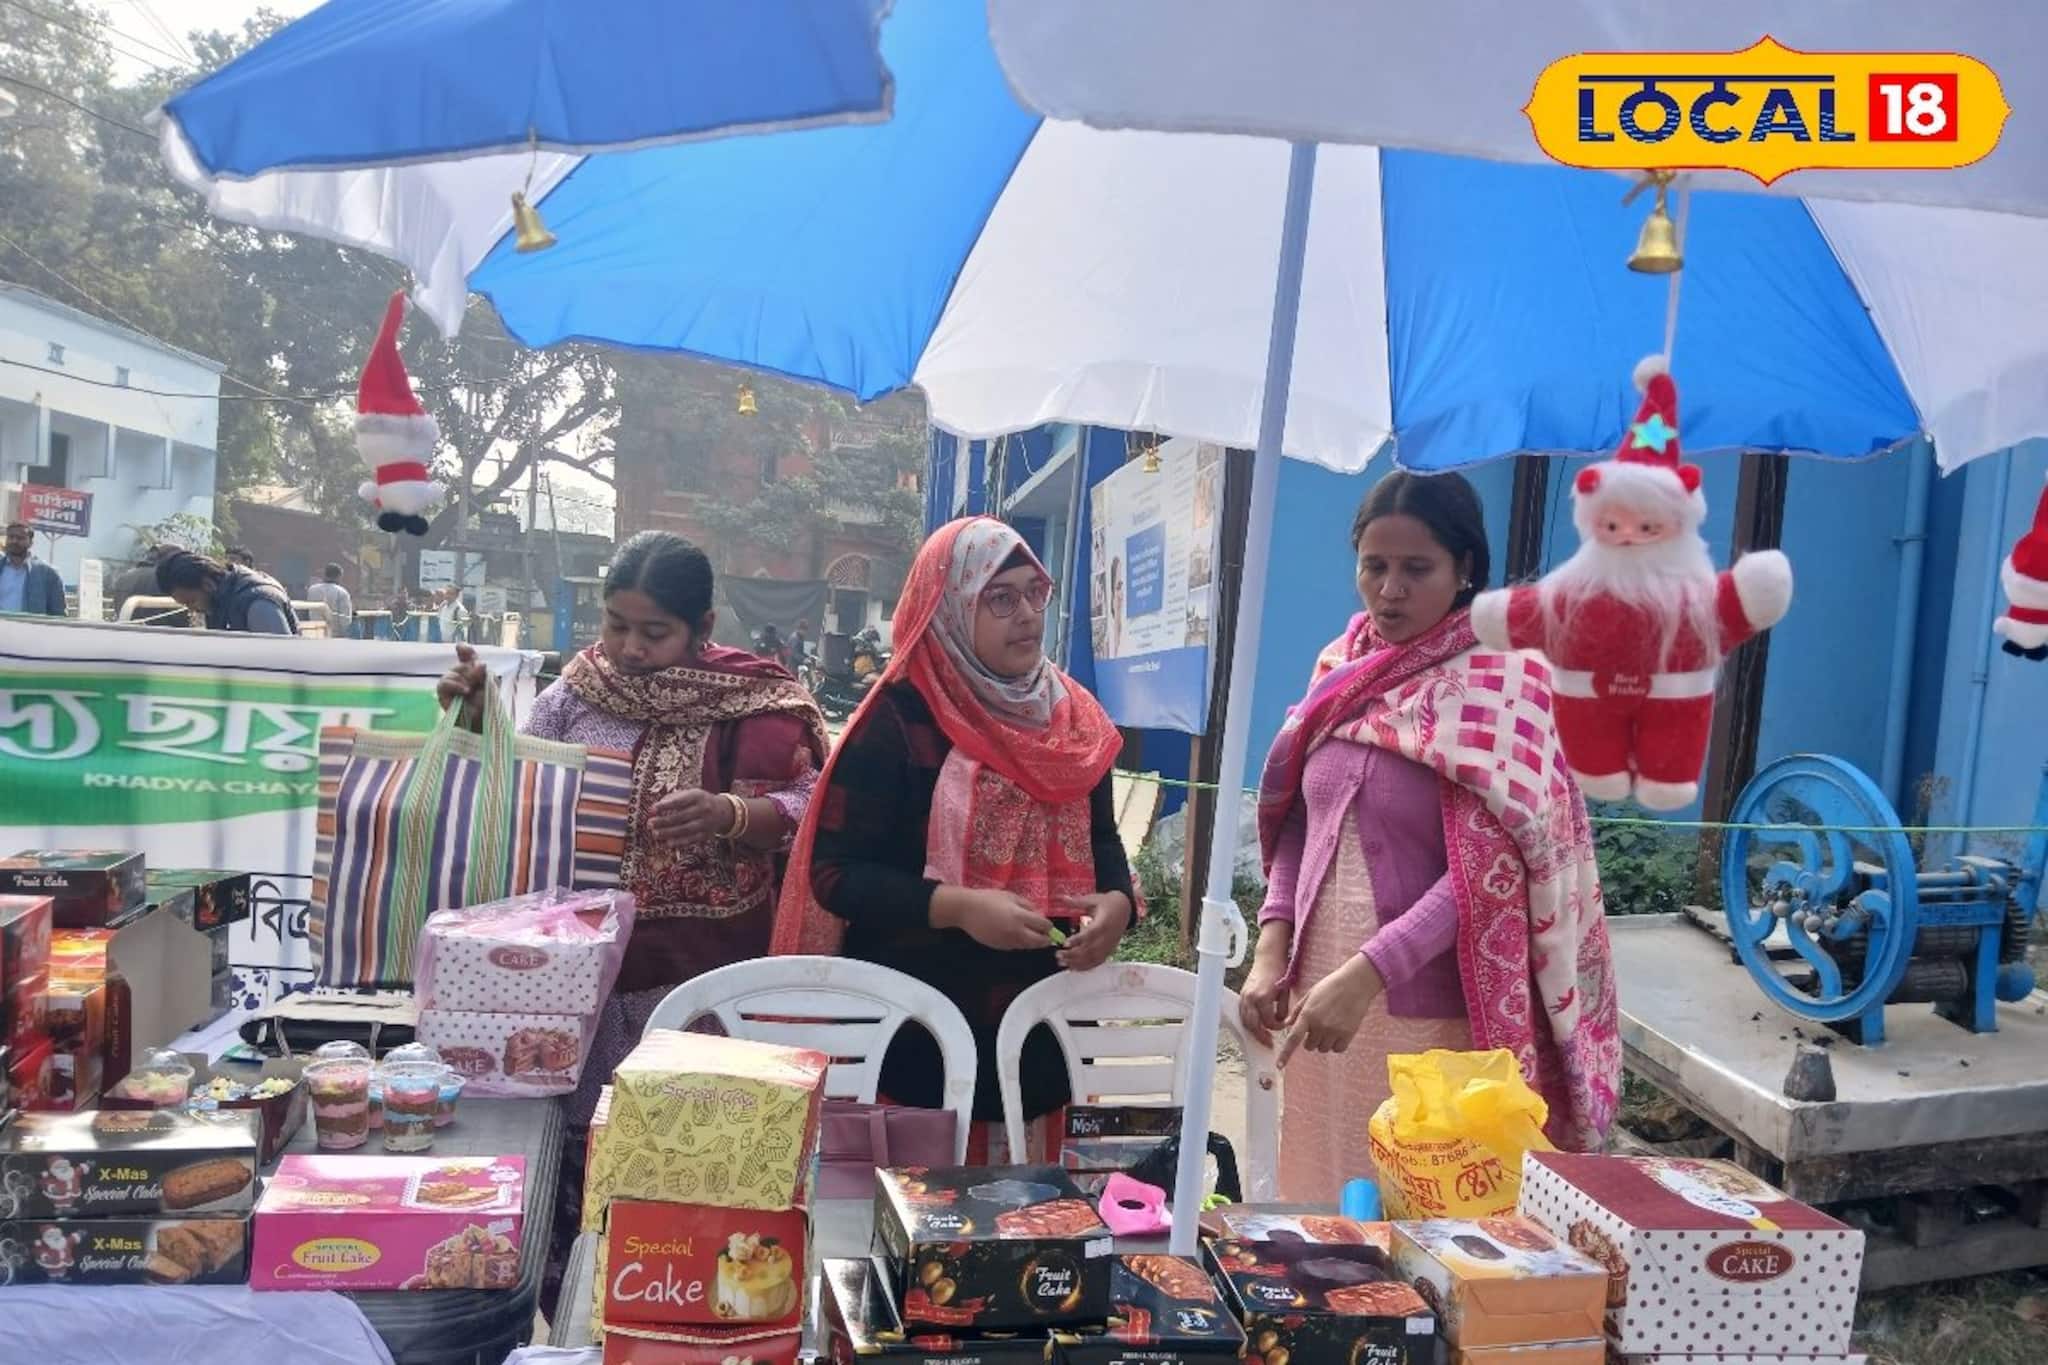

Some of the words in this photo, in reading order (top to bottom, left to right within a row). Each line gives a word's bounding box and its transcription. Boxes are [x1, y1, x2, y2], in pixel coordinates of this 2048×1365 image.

[0, 688, 103, 761] দ্য
[83, 772, 217, 794] KHADYA
[12, 874, 41, 888] Fruit
[42, 875, 69, 888] Cake
[499, 951, 540, 967] CAKE
[99, 1167, 149, 1181] X-Mas
[83, 1184, 129, 1204] Special
[93, 1236, 143, 1251] X-Mas
[623, 1235, 695, 1259] Special
[1734, 1246, 1772, 1256] Special
[79, 1253, 123, 1271] Special
[126, 1252, 151, 1270] Cak
[302, 1252, 336, 1264] Fruit
[340, 1251, 373, 1264] Cake
[1722, 1254, 1780, 1275] CAKE
[1035, 1266, 1071, 1282] Fruit
[612, 1260, 705, 1306] Cake
[1036, 1281, 1072, 1297] Cake
[1364, 1343, 1398, 1357] Fruit
